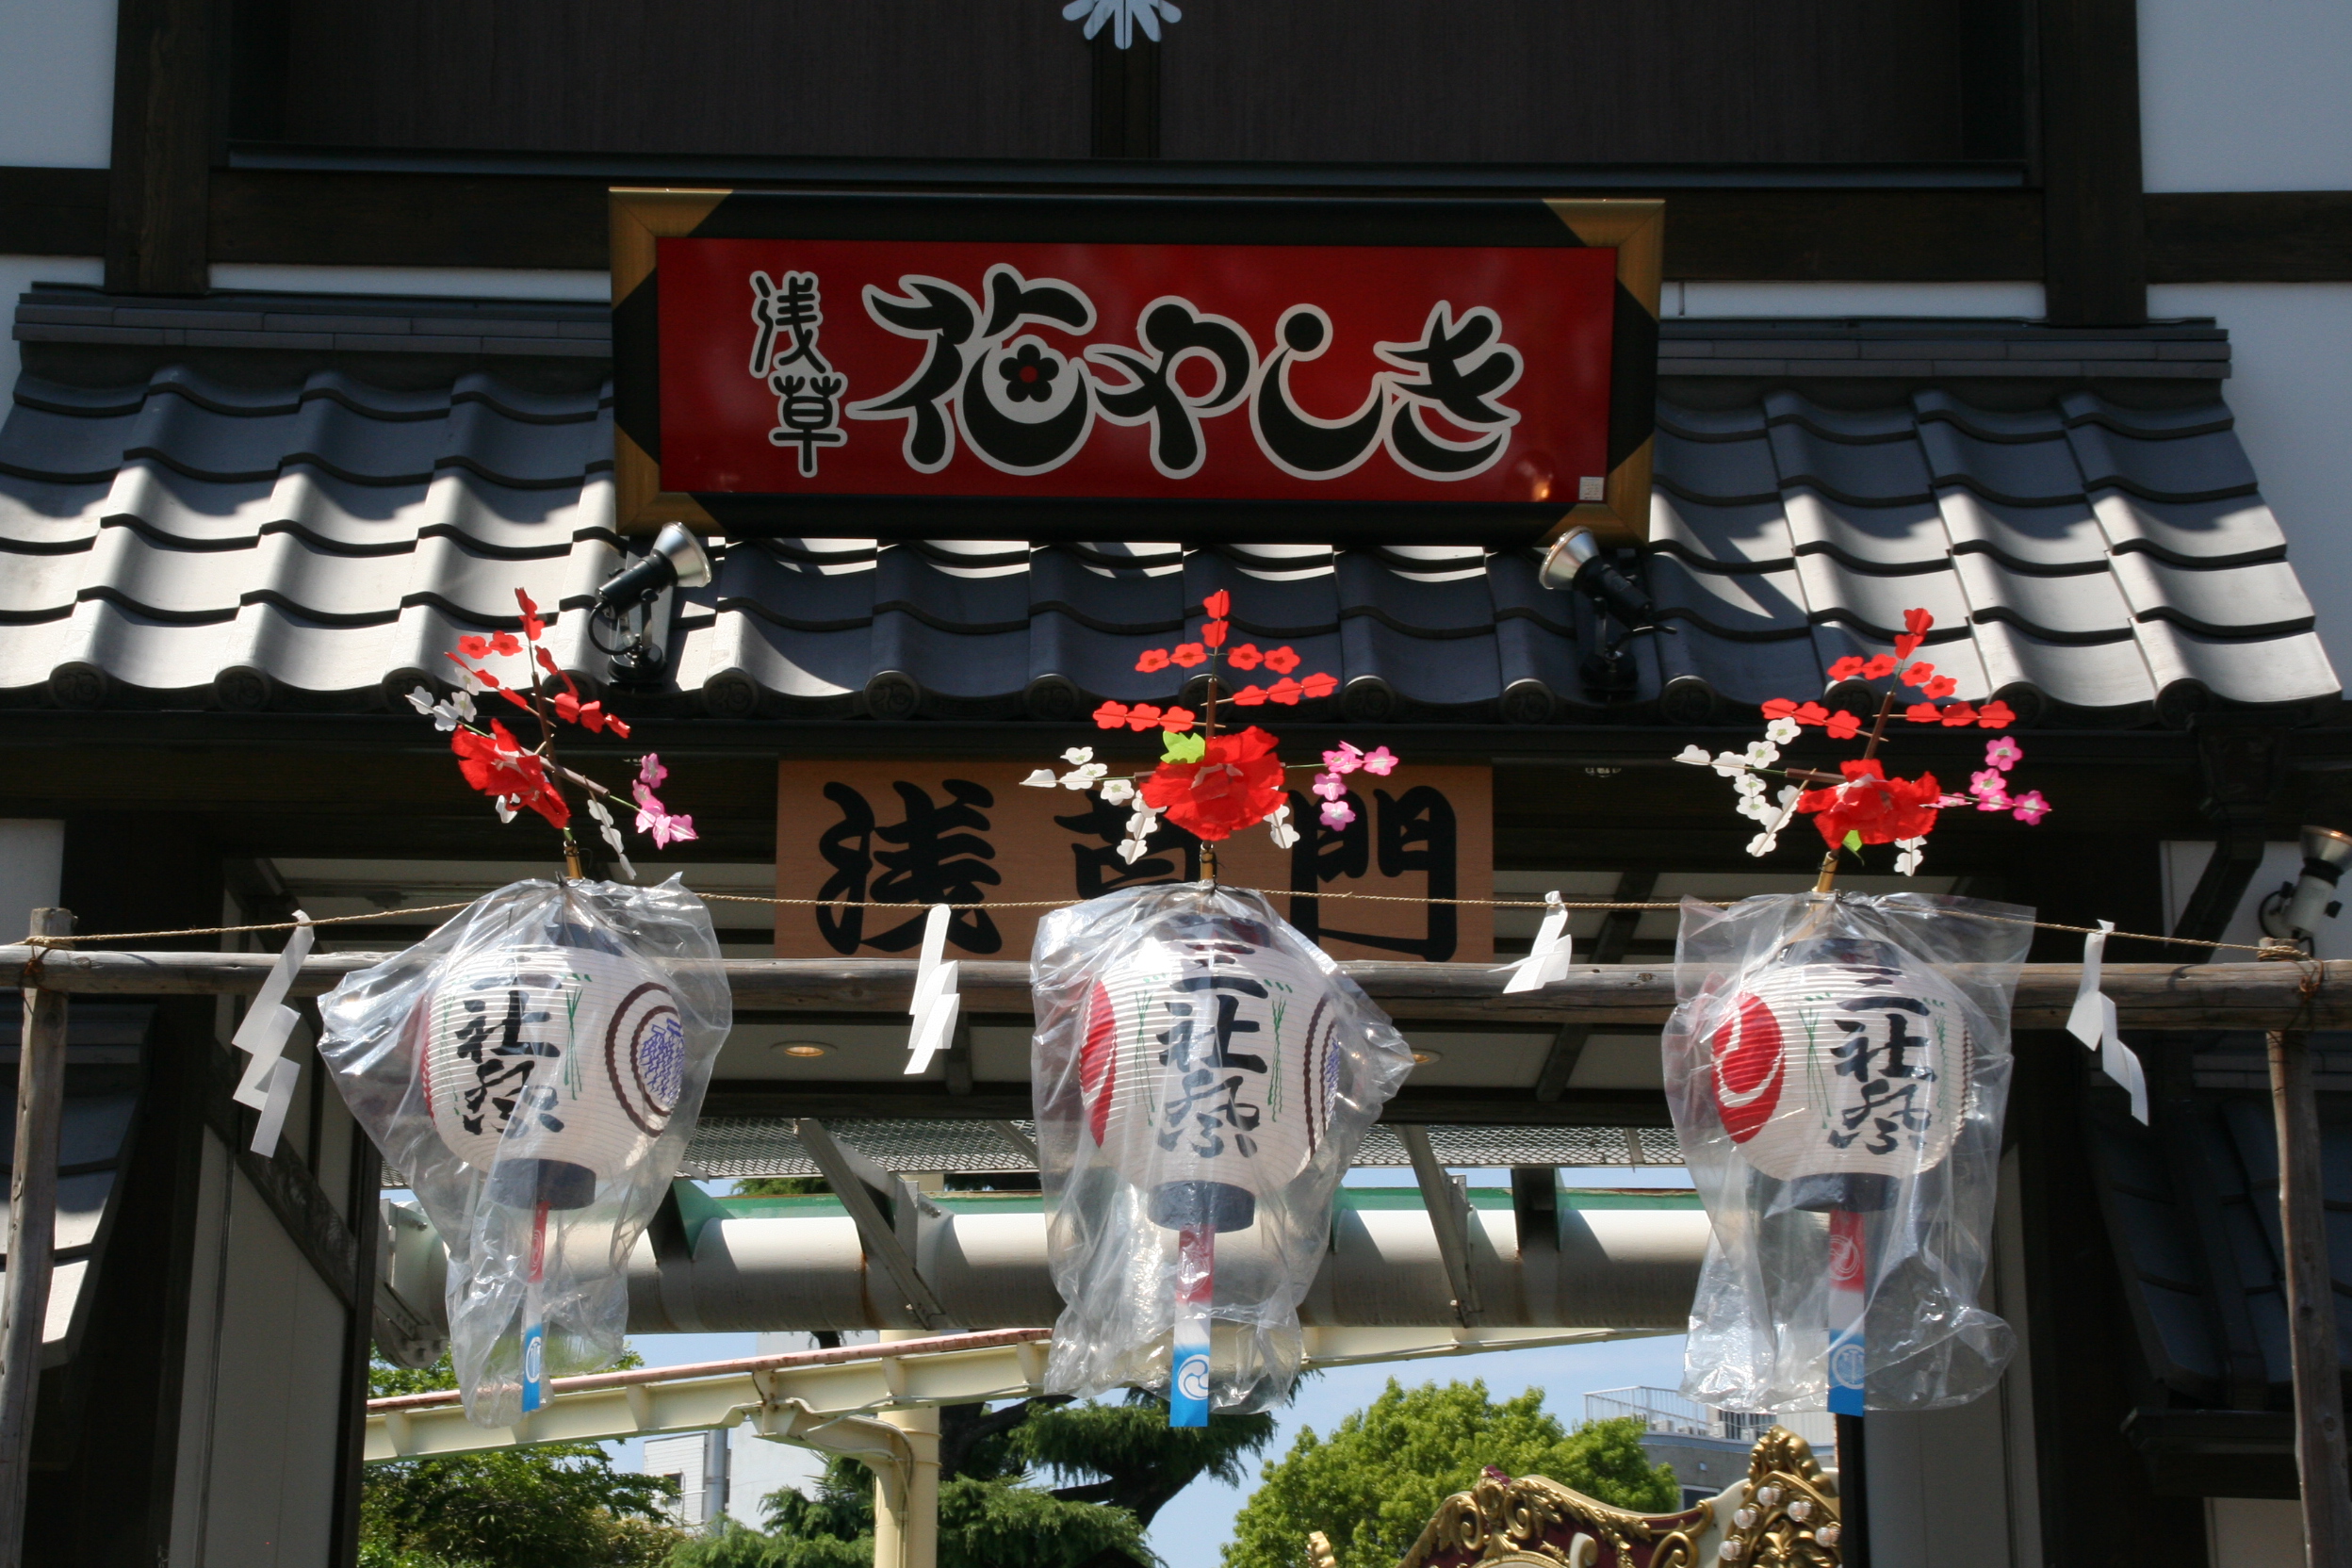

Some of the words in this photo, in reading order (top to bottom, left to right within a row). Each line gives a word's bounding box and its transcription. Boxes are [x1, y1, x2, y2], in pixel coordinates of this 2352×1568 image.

[750, 270, 849, 478] 浅草
[844, 262, 1525, 483] 花やしき
[1155, 942, 1269, 1158] 三社祭
[1827, 967, 1937, 1155] 三社祭
